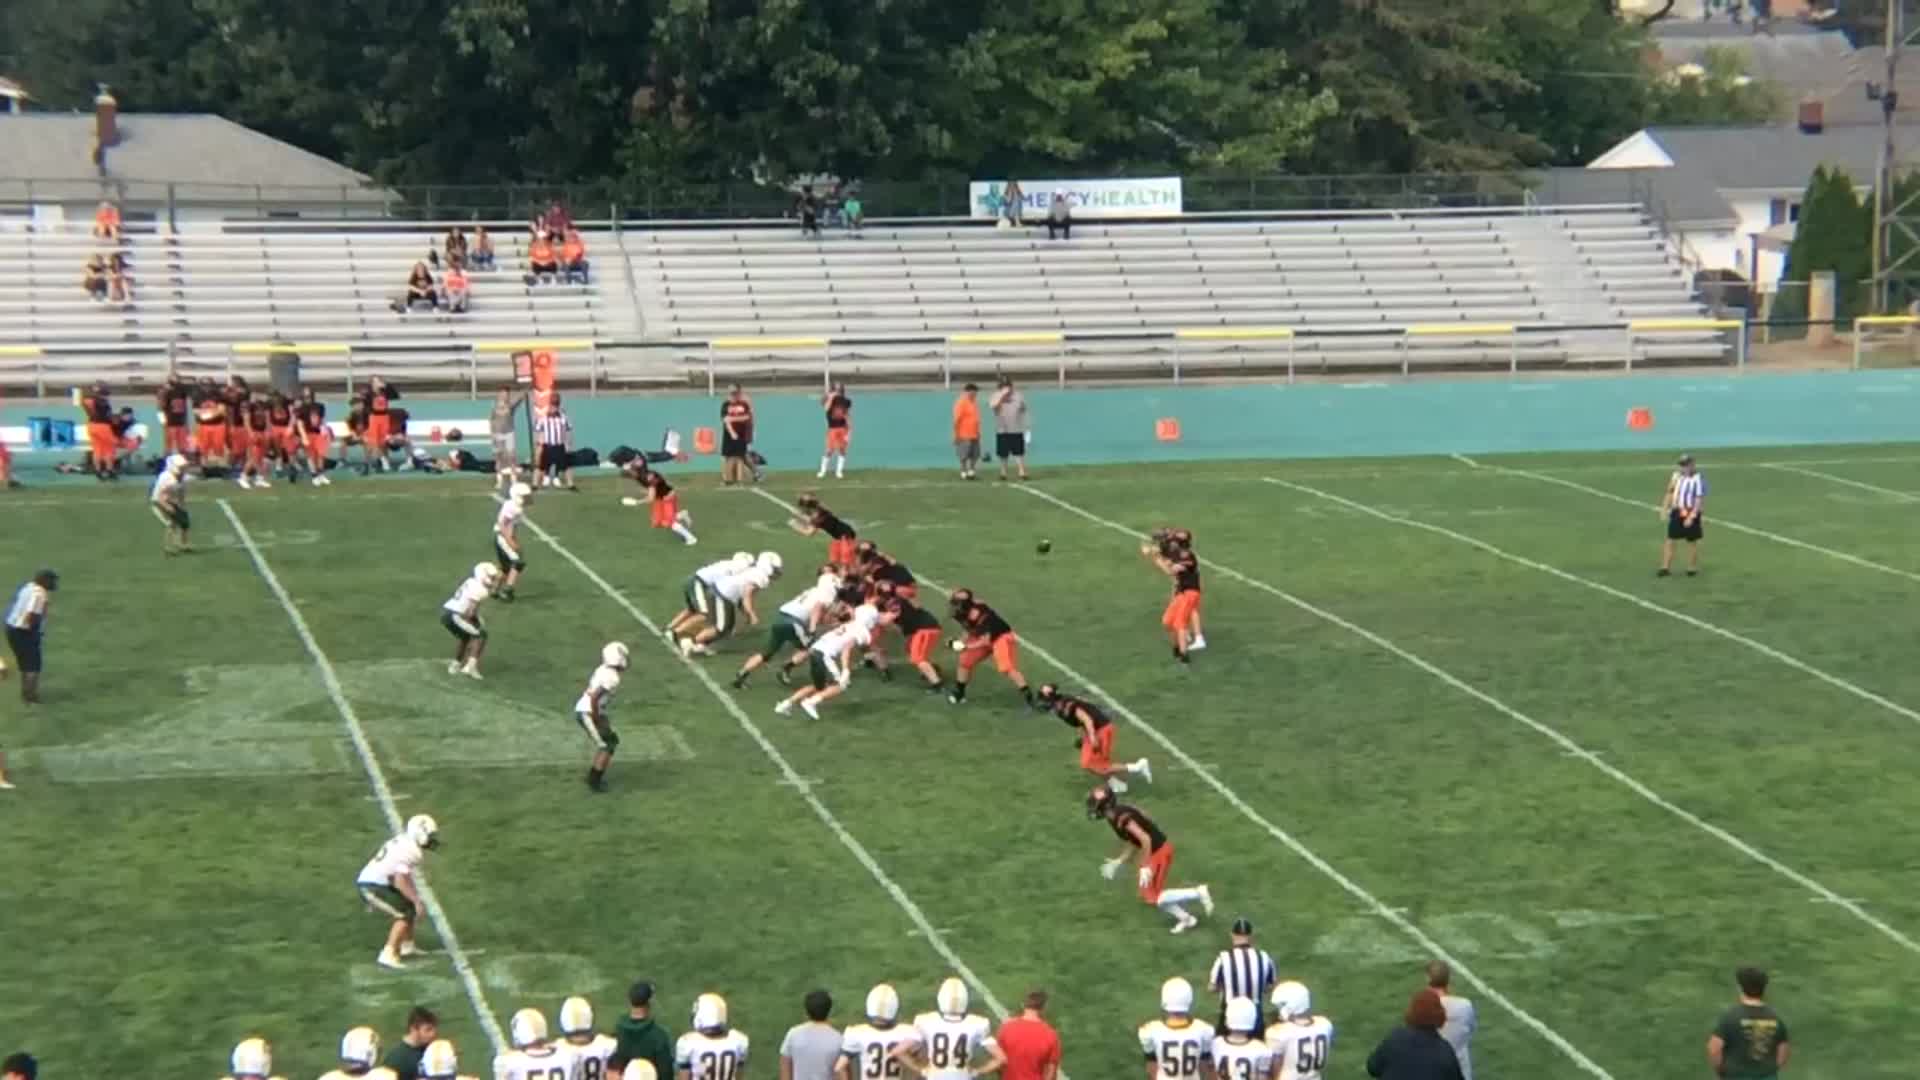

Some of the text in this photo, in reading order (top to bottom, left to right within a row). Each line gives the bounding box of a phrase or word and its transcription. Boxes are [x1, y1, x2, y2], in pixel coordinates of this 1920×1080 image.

[1020, 189, 1177, 207] MECYHEALTH
[701, 1051, 736, 1080] 30
[866, 1041, 900, 1078] 32
[933, 1033, 968, 1069] 84
[1162, 1040, 1200, 1077] 56
[1297, 1034, 1328, 1073] 50
